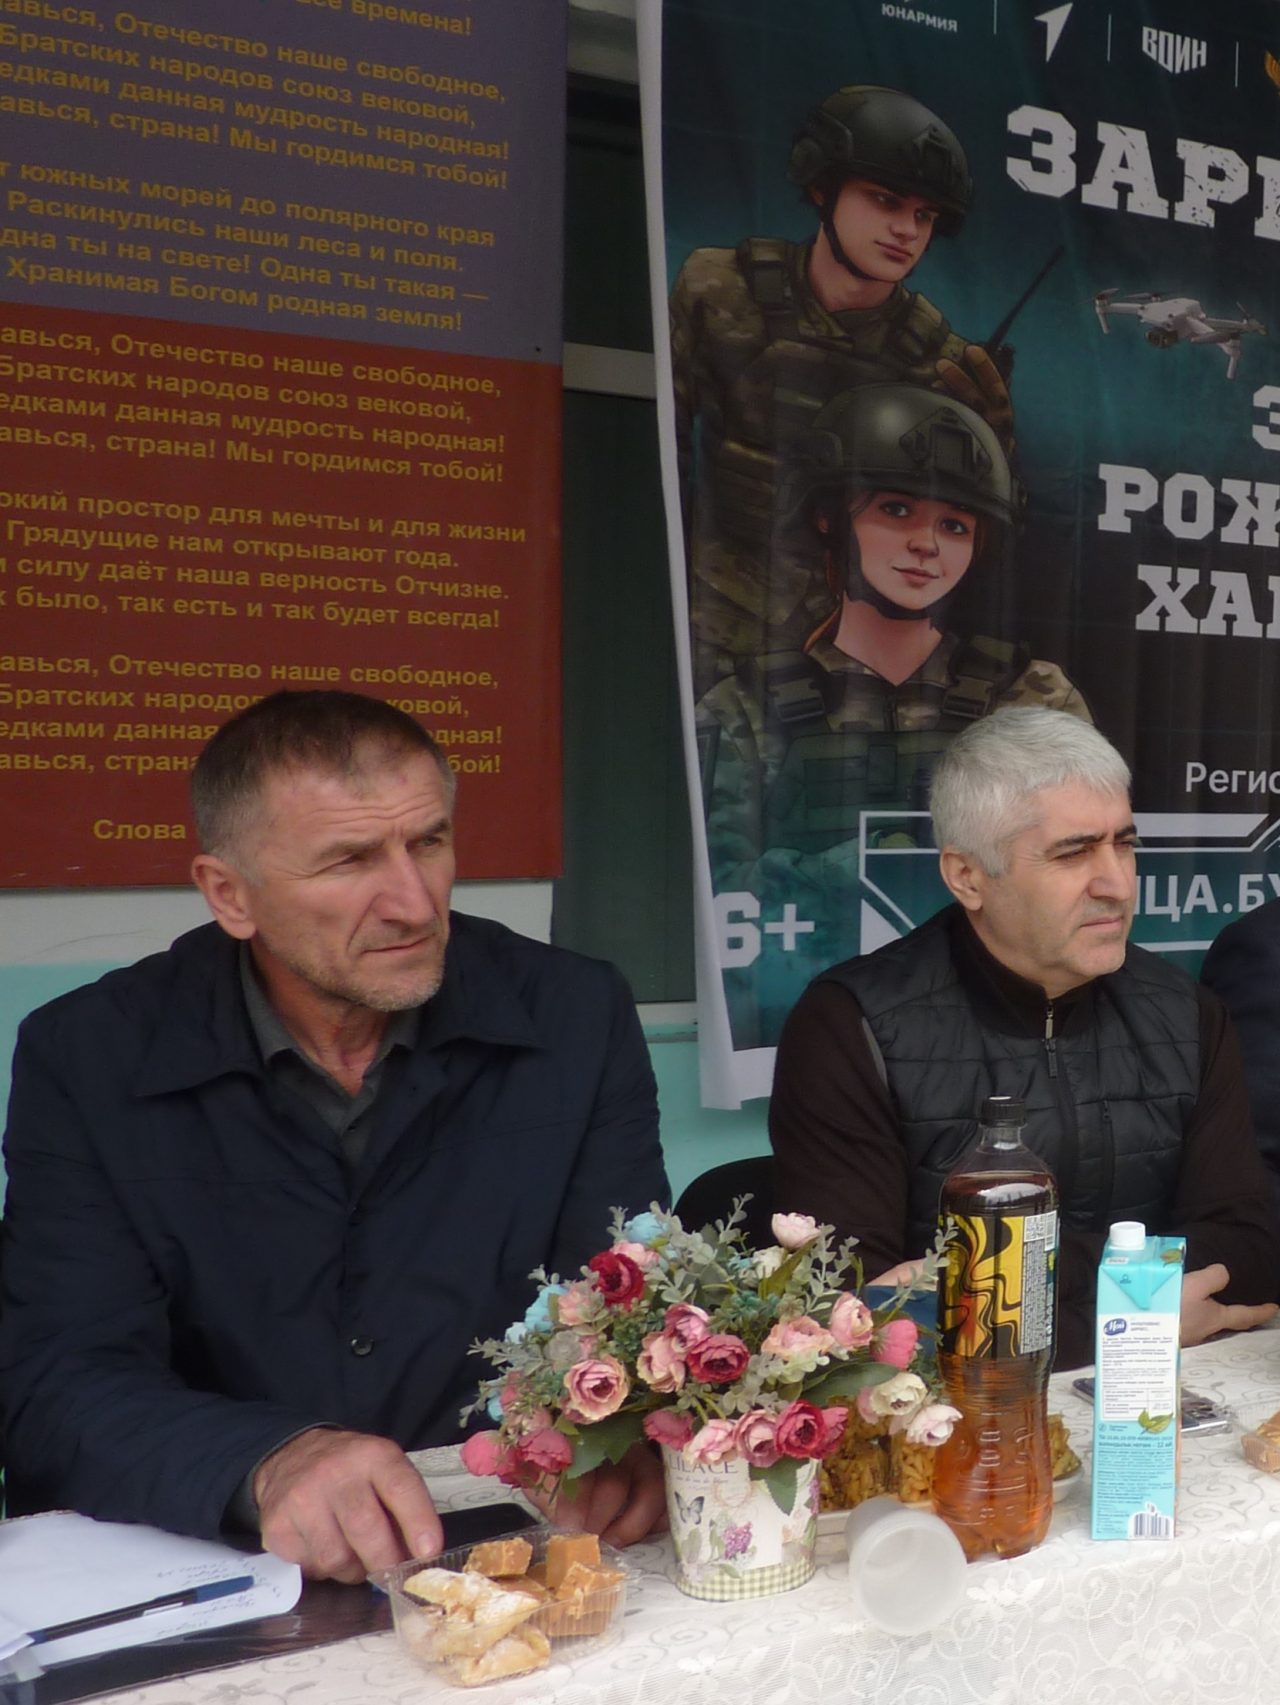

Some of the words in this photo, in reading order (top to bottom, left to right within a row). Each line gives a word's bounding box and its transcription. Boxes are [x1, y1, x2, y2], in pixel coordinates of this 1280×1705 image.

[351, 0, 472, 36] времена!
[881, 3, 958, 32] ЮНАРМИЯ
[0, 0, 104, 32] авься,
[114, 11, 268, 58] Отечество
[276, 46, 348, 72] наше
[356, 64, 505, 102] свободное,
[1142, 26, 1207, 74] ВОИН
[0, 24, 140, 67] Братских
[149, 55, 273, 90] народов
[282, 78, 352, 104] союз
[361, 92, 476, 128] вековой,
[118, 81, 225, 114] данная
[235, 101, 368, 137] мудрость
[376, 125, 509, 160] народная!
[109, 112, 219, 144] страна!
[229, 127, 277, 154] Мы
[285, 141, 416, 176] гордимся
[423, 161, 508, 189] тобой!
[20, 164, 130, 194] южных
[139, 181, 232, 208] морей
[240, 197, 276, 216] до
[285, 202, 429, 238] полярного
[437, 225, 496, 247] края
[7, 190, 205, 237] Раскинулись
[215, 224, 289, 249] наши
[299, 236, 361, 259] леса
[369, 246, 386, 262] и
[394, 249, 464, 272] поля.
[67, 235, 107, 256] ты
[117, 243, 152, 262] на
[161, 248, 250, 274] свете!
[260, 258, 332, 285] Одна
[341, 271, 376, 290] ты
[384, 277, 456, 301] такая
[6, 256, 160, 294] Хранимая
[169, 276, 258, 307] Богом
[267, 292, 367, 321] родная
[376, 306, 463, 331] земля!
[0, 354, 136, 389] Братских
[146, 376, 269, 402] народов
[278, 388, 348, 410] союз
[358, 396, 471, 421] вековой,
[111, 333, 264, 369] Отечество
[273, 355, 343, 377] наше
[352, 364, 502, 397] свободное,
[114, 402, 221, 427] данная
[231, 415, 363, 441] мудрость
[371, 429, 505, 453] народная!
[106, 433, 216, 460] страна!
[226, 441, 274, 464] Мы
[283, 451, 412, 475] гордимся
[420, 460, 503, 482] тобой!
[6, 519, 159, 551] Грядущие
[168, 535, 223, 554] нам
[233, 539, 386, 566] открывают
[395, 548, 459, 569] года.
[78, 496, 200, 523] простор
[208, 506, 262, 525] для
[271, 511, 361, 532] мечты
[368, 518, 384, 533] и
[391, 518, 441, 538] для
[449, 523, 527, 543] жизни
[16, 557, 90, 582] силу
[98, 563, 167, 583] даёт
[176, 567, 250, 588] наша
[259, 572, 387, 595] верность
[395, 575, 510, 600] Отчизне.
[16, 585, 108, 614] было,
[118, 595, 164, 615] так
[172, 599, 237, 619] есть
[245, 603, 262, 619] и
[272, 604, 315, 621] так
[322, 603, 399, 627] будет
[407, 608, 500, 630] всегда!
[108, 654, 261, 680] Отечество
[271, 664, 341, 683] наше
[349, 664, 498, 689] свободное,
[0, 683, 134, 710] Братских
[386, 697, 469, 718] овой,
[427, 725, 502, 747] дная!
[93, 818, 187, 842] Слова
[712, 891, 815, 969] 6+
